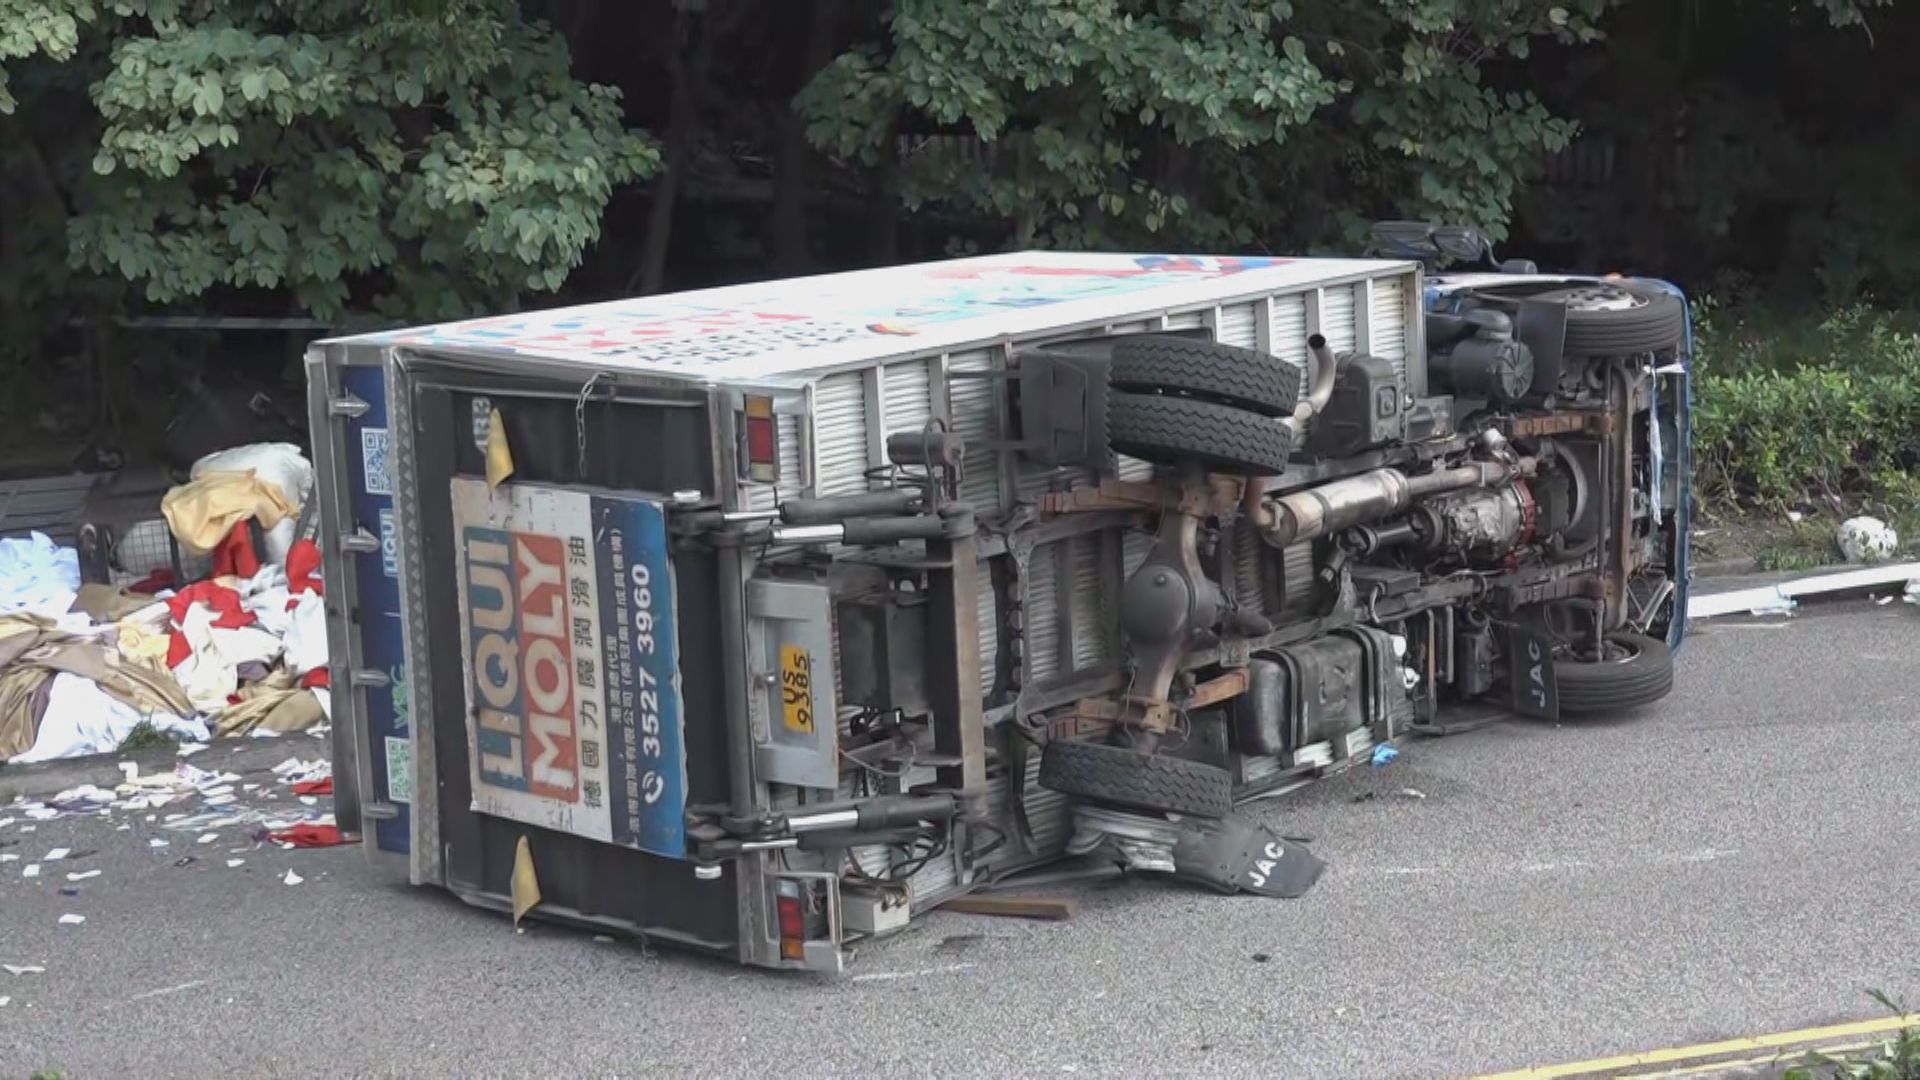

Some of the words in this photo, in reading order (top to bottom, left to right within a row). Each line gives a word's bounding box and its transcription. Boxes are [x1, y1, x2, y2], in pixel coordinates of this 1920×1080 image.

[382, 513, 398, 572] LIQUI
[631, 563, 654, 654] 3960
[468, 538, 525, 782] LIQUI
[516, 537, 577, 790] MOLY
[568, 535, 602, 809] 德國力魔潤滑油
[783, 669, 798, 704] US
[794, 653, 810, 725] 9385
[1528, 639, 1546, 708] JAC
[640, 666, 661, 758] 3527
[1248, 841, 1284, 887] JAC
